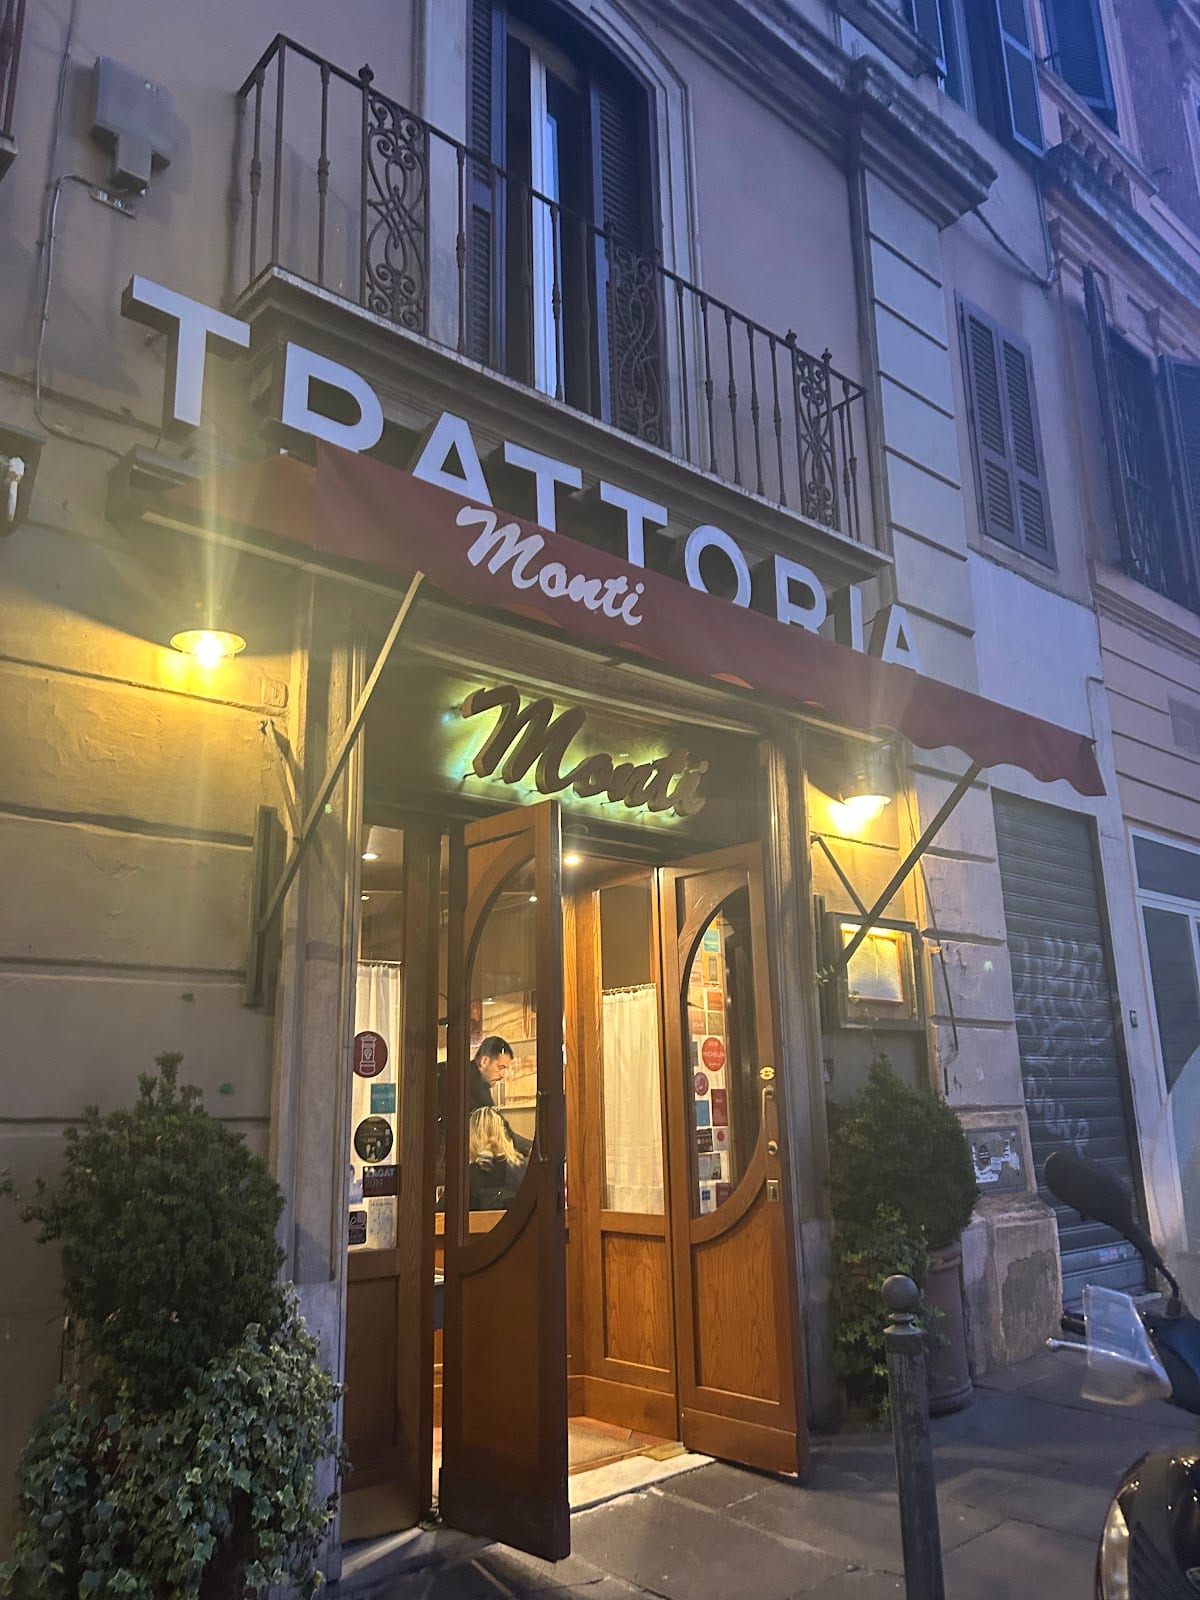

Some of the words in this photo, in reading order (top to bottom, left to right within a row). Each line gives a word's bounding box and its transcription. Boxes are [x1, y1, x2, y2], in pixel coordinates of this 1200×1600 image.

[128, 274, 924, 674] TRATTORIA
[456, 505, 645, 626] Monti
[461, 684, 709, 816] Monti
